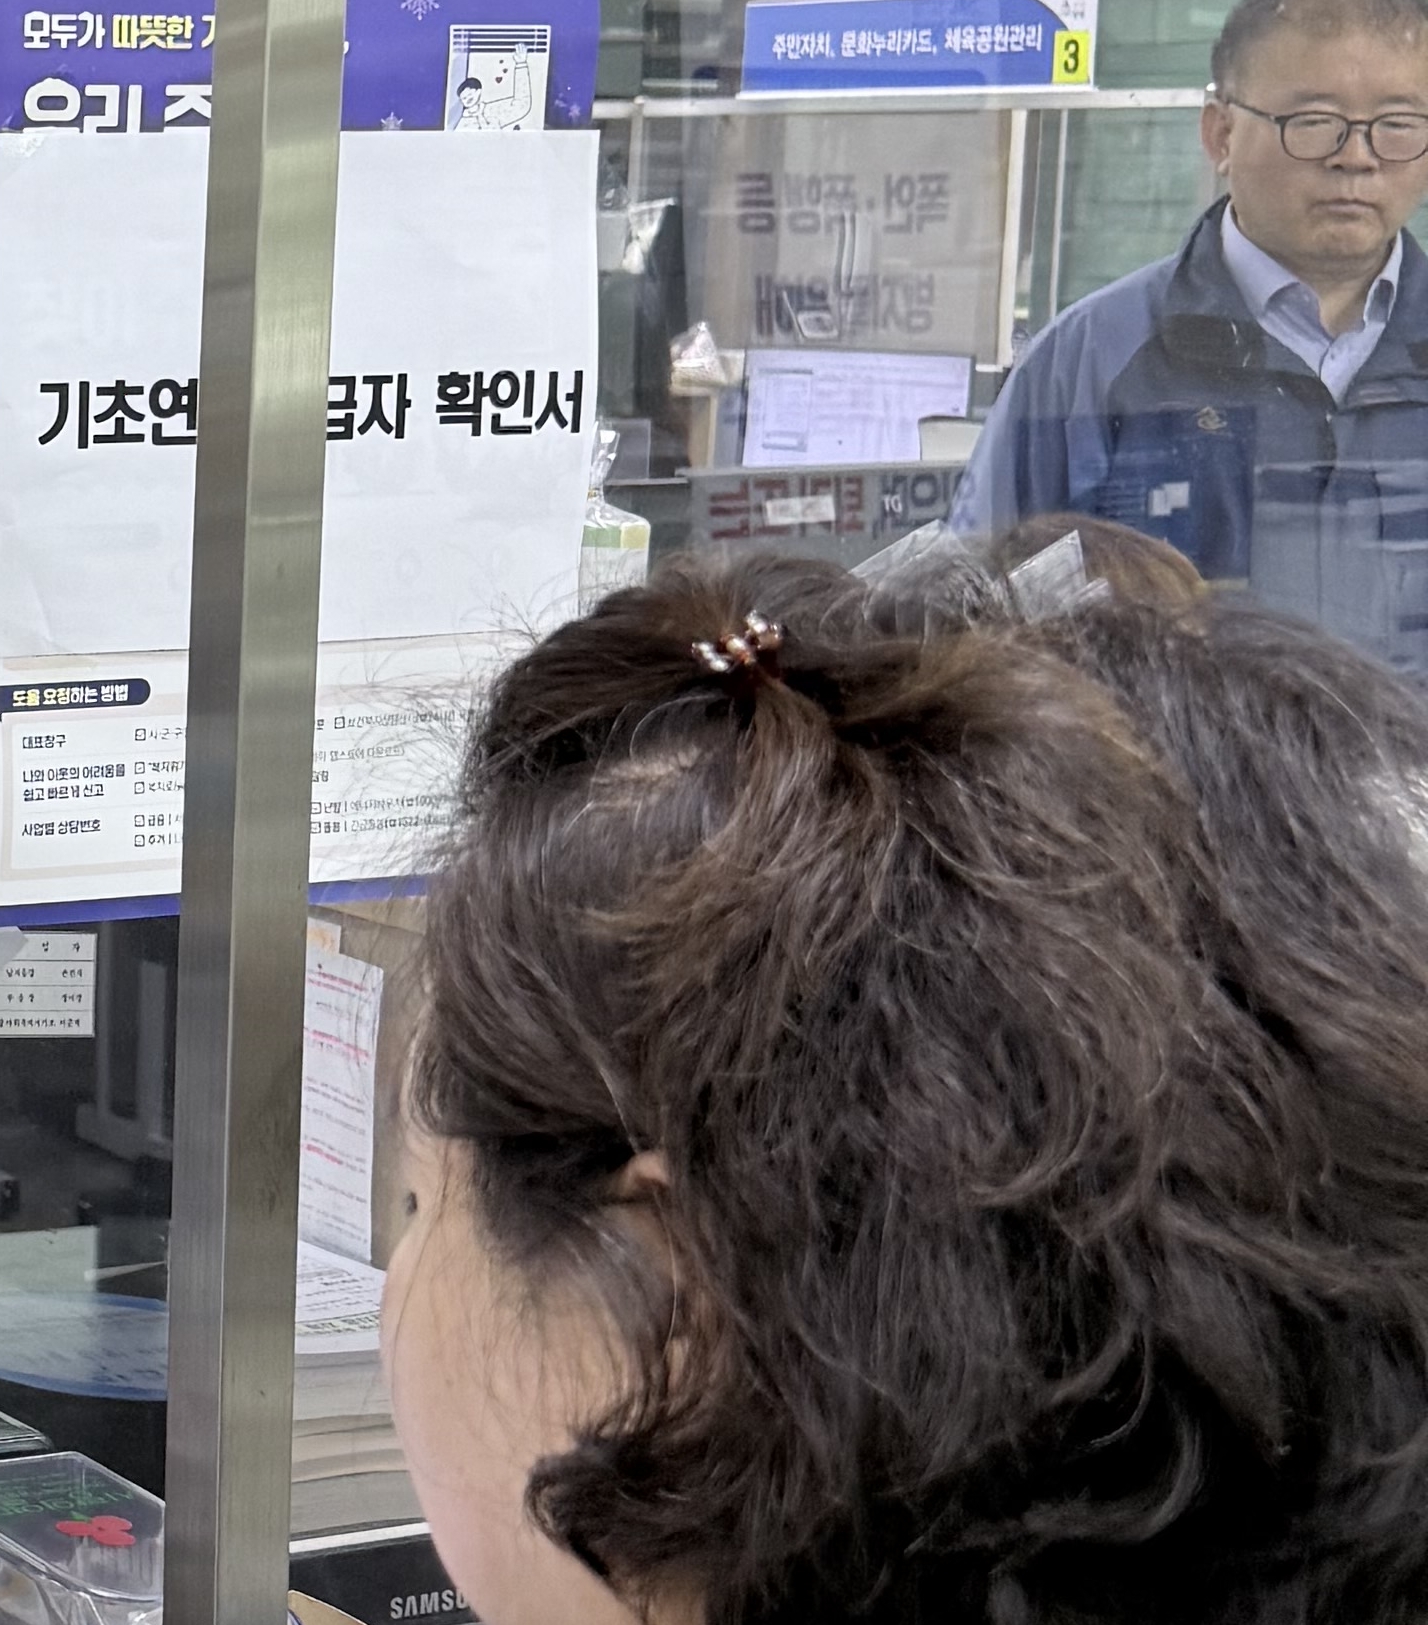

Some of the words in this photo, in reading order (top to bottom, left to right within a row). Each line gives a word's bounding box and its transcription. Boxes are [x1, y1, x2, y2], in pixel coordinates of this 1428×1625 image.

[24, 11, 105, 48] 모두가
[113, 15, 194, 49] 따뜻한
[1064, 40, 1079, 73] 3
[436, 370, 583, 436] 확인서
